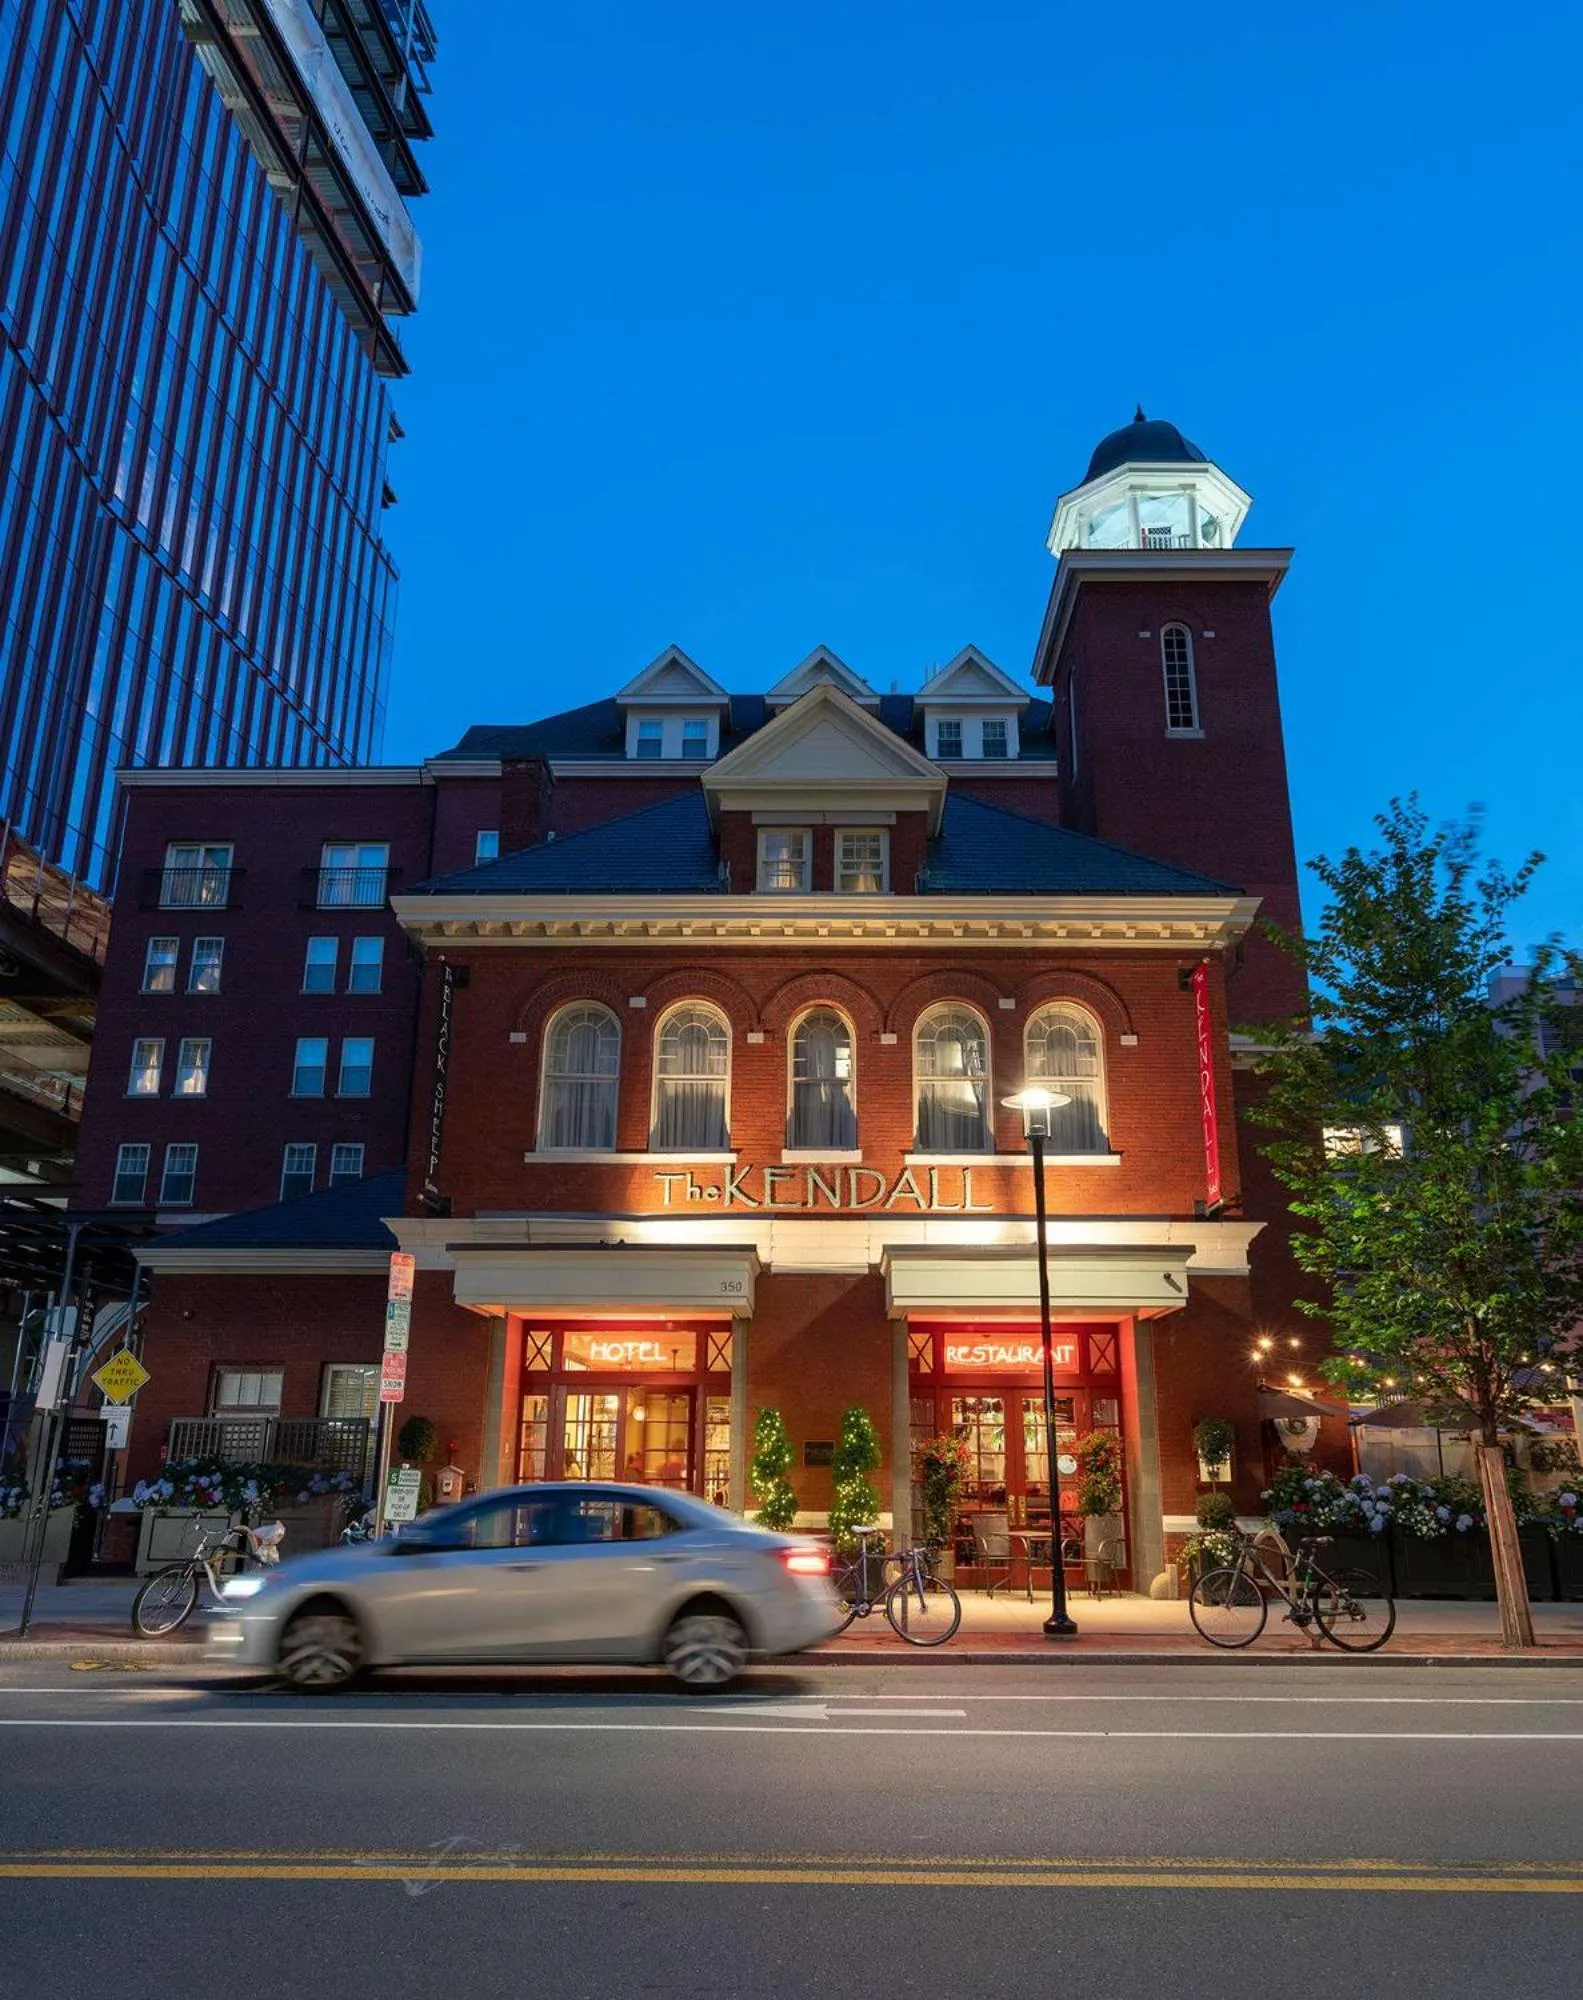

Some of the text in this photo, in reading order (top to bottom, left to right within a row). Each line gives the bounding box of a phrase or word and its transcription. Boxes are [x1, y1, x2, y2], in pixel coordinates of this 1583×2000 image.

[654, 1164, 993, 1210] The KENDALL
[720, 1281, 742, 1293] 350
[589, 1341, 667, 1361] HOTEL
[946, 1345, 1074, 1363] RESTAURANT
[111, 1368, 134, 1376] THRU
